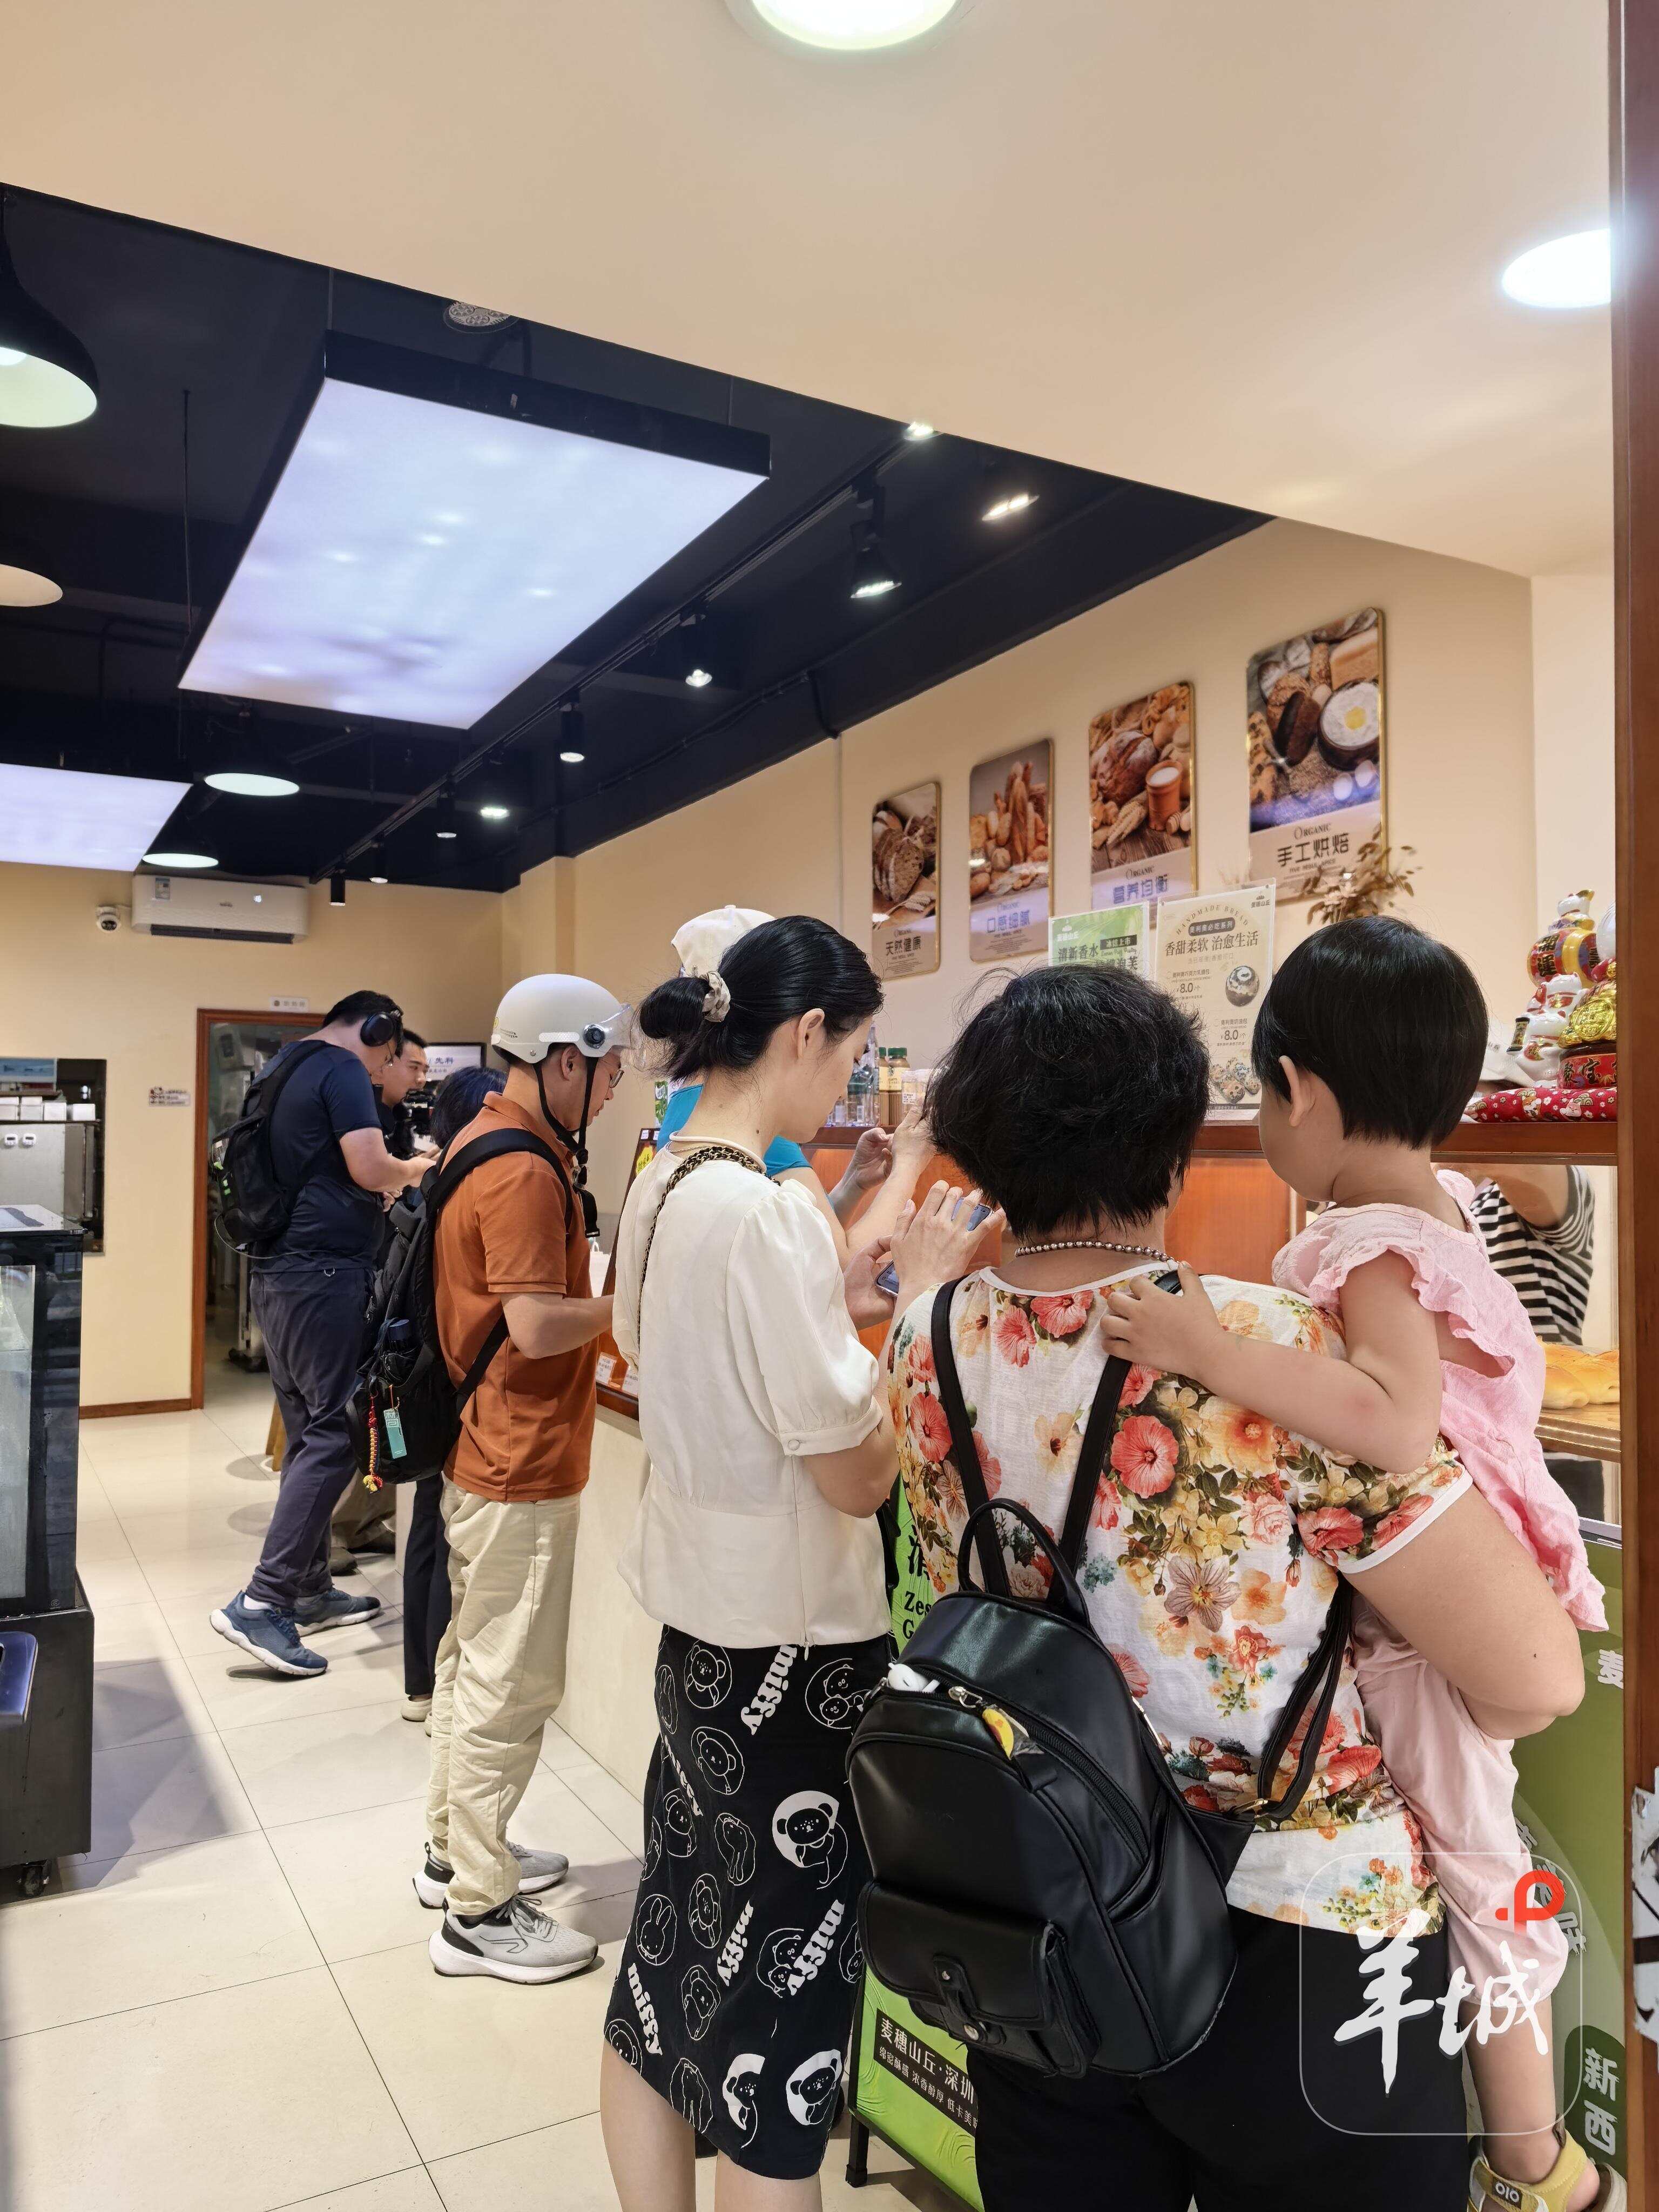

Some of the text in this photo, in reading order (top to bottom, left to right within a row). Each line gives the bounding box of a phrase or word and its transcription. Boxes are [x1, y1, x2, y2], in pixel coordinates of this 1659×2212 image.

[1277, 832, 1350, 867] 手工烘焙
[1112, 873, 1169, 905] 营养均衡
[886, 936, 921, 956] 天然健康
[1165, 930, 1259, 956] 香甜柔软 治愈生活
[741, 1644, 798, 1735] miffy
[787, 1899, 845, 1997] miffy
[628, 1962, 663, 2056] miffy
